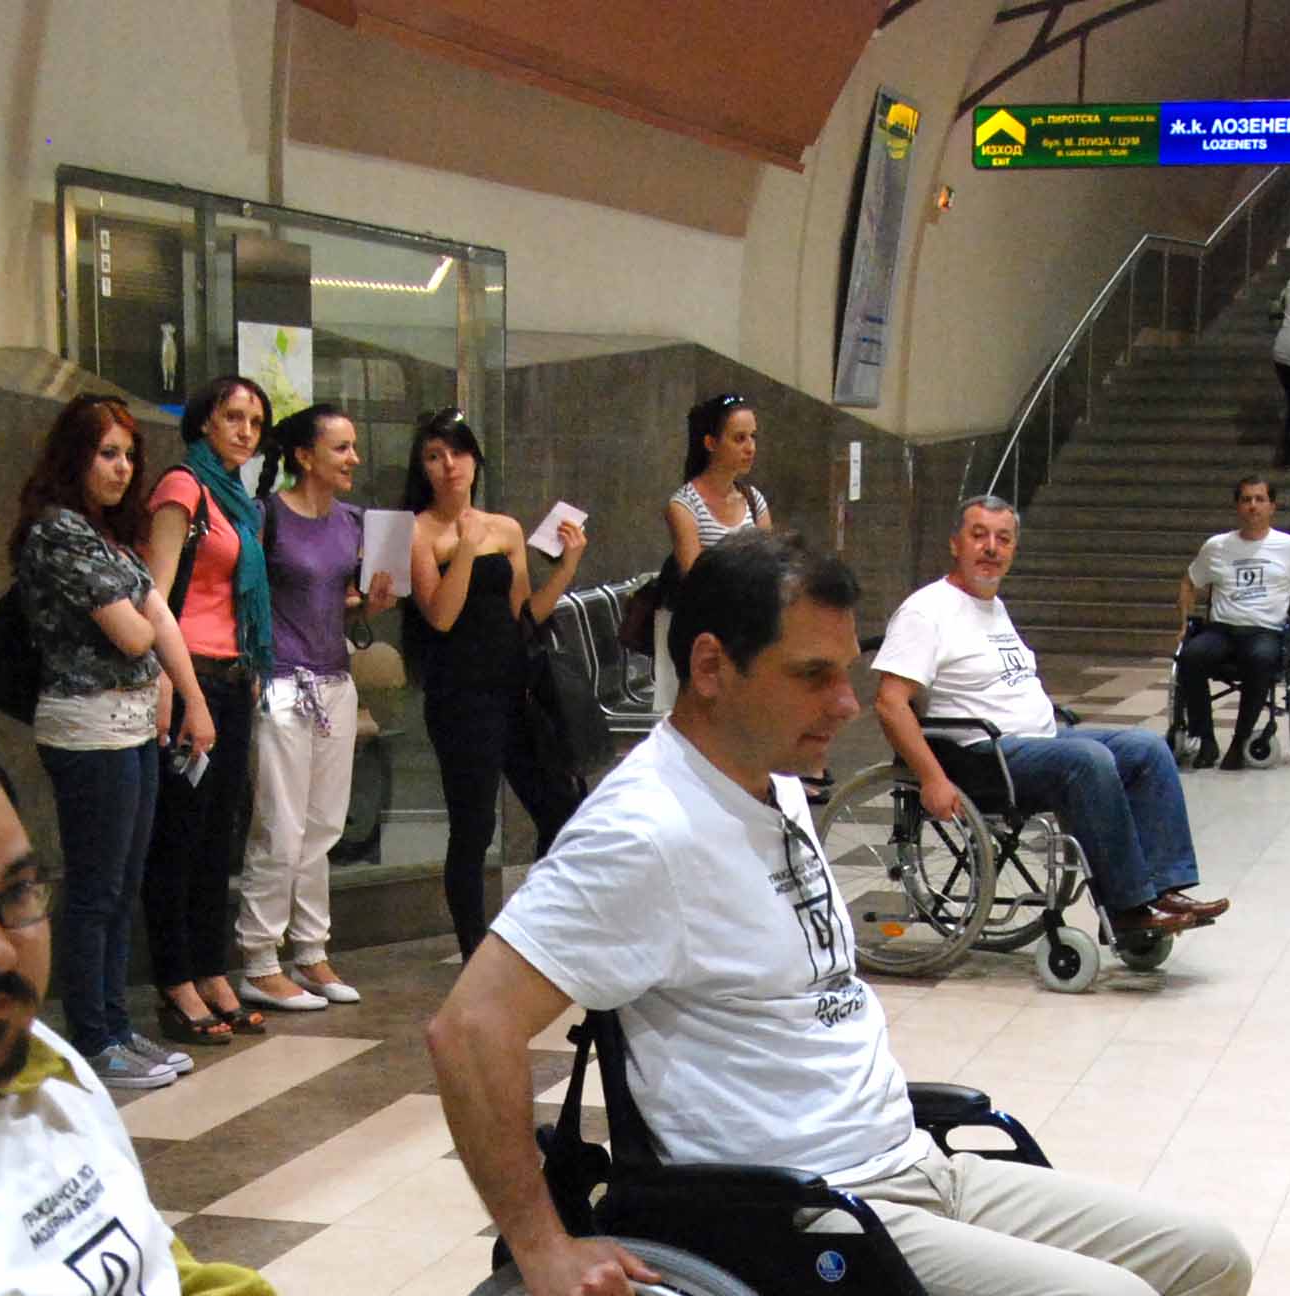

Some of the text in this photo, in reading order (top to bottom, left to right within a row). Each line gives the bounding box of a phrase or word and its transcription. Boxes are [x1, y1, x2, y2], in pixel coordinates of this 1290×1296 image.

[1047, 113, 1101, 125] ПИРОТСКА
[981, 144, 1023, 157] ИЗХОД
[1202, 139, 1268, 150] LOZENETS
